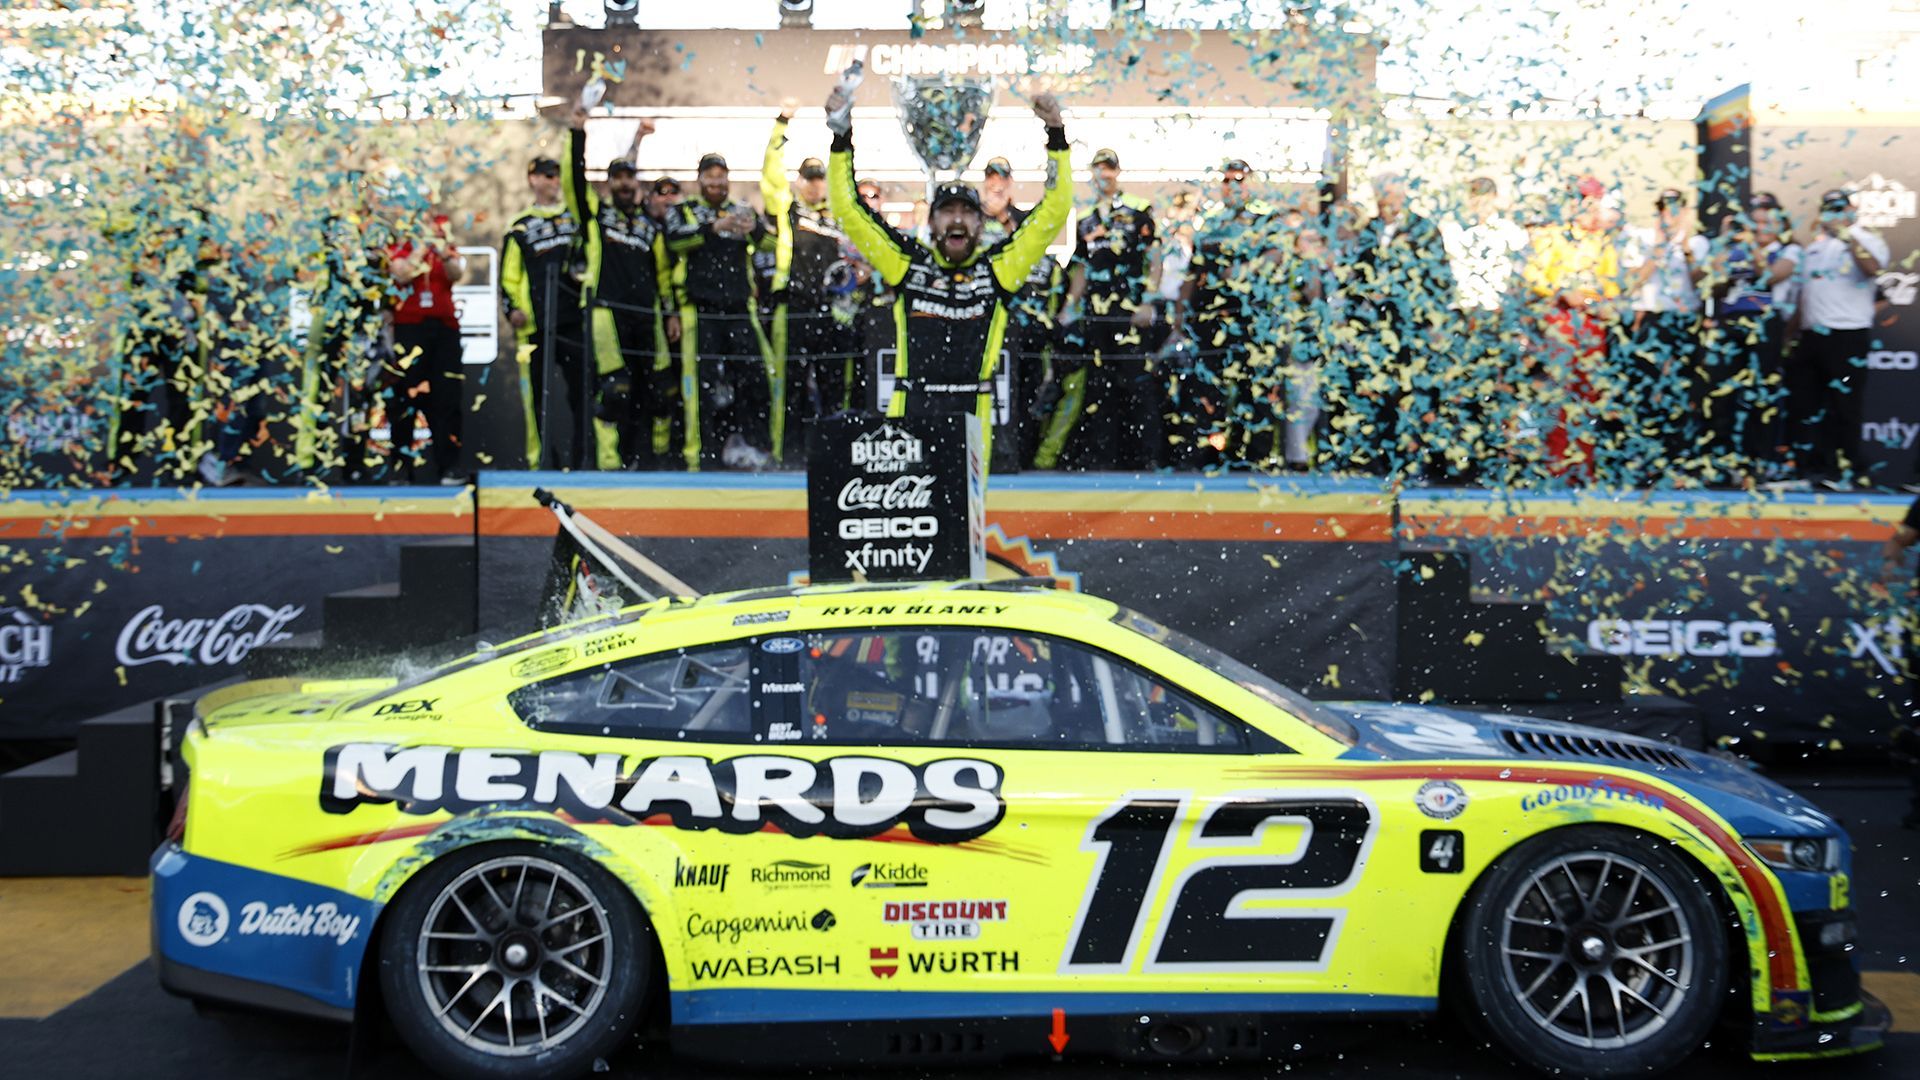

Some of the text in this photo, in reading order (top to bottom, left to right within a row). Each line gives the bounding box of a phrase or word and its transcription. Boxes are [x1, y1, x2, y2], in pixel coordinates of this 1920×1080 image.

[1867, 350, 1918, 370] ICO
[851, 438, 923, 466] BUSCH
[865, 461, 907, 474] LIGHT
[837, 474, 938, 512] Coca-Cola
[838, 515, 939, 540] GEICO
[844, 541, 934, 575] xfinity
[822, 605, 1009, 616] RYAN BLANEY
[115, 604, 304, 667] Coca-Col
[584, 637, 637, 657] DEERY
[1587, 619, 1777, 657] GEICO
[761, 682, 804, 693] Mazak
[372, 697, 441, 716] DEX
[330, 744, 1000, 831] MENARDS
[1429, 835, 1456, 868] 4
[751, 864, 830, 883] Richmond
[874, 863, 928, 880] Kidde
[1057, 789, 1380, 974] 12
[884, 901, 1008, 922] DISCOUNT
[686, 911, 807, 944] Capgemini
[919, 925, 972, 937] TIRE
[692, 956, 840, 980] WABASH
